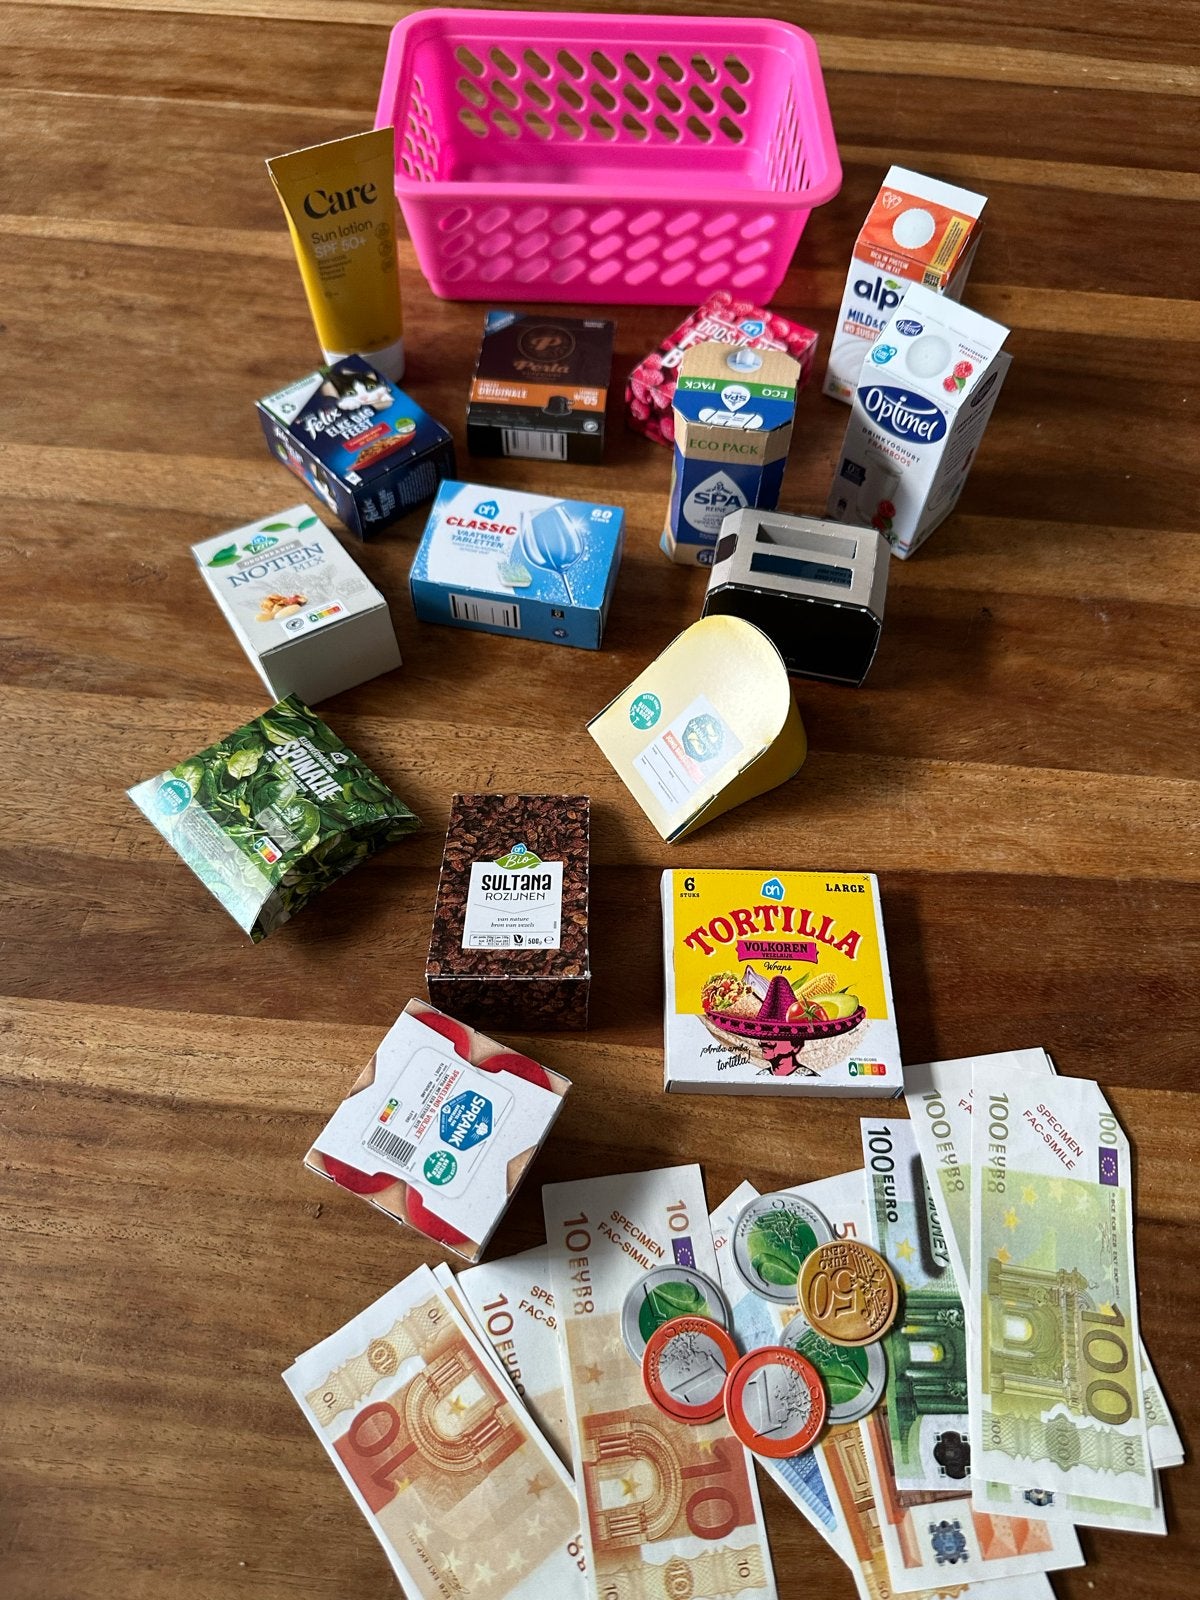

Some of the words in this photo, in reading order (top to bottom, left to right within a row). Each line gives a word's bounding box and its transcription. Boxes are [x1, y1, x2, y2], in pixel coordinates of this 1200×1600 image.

[303, 182, 378, 219] Care
[311, 230, 337, 244] Sun
[338, 220, 373, 238] lotion
[314, 241, 338, 258] SPF
[853, 276, 905, 311] alp
[512, 358, 571, 374] Perla
[684, 380, 716, 391] PACK
[723, 392, 748, 402] SPA
[761, 388, 789, 399] ECO
[304, 407, 343, 441] felix
[324, 416, 352, 438] ELKE
[350, 407, 376, 426] DAG
[865, 387, 939, 441] Optimel
[341, 419, 374, 441] FEEST
[689, 439, 719, 451] ECO
[722, 441, 758, 455] PACK
[861, 427, 921, 463] DRINKYOGHURT
[867, 439, 912, 467] FRAMBOOS
[693, 491, 742, 508] SPA
[705, 505, 727, 513] REINE
[446, 516, 518, 536] CLASSIC
[591, 508, 613, 519] 60
[452, 534, 504, 549] TABLETTEN
[457, 529, 502, 542] VAATWAS
[227, 541, 325, 588] NOTEN
[293, 556, 326, 573] MIX
[274, 740, 345, 802] SPINAZIE
[503, 854, 535, 868] Bio
[481, 874, 552, 891] SULTANA
[684, 877, 696, 892] 6
[825, 883, 866, 894] LARGE
[485, 892, 546, 901] ROZIJNEN
[683, 904, 863, 961] TORTILLA
[743, 941, 809, 954] VOLKOREN
[763, 960, 793, 974] Wraps
[448, 1095, 487, 1147] SPRANK
[988, 1092, 1010, 1141] 100
[1098, 1111, 1118, 1145] 100
[922, 1088, 952, 1139] 100
[944, 1141, 965, 1192] EURO
[1022, 1109, 1076, 1171] FAC-SIMILE
[1036, 1103, 1084, 1157] SPECIMEN
[867, 1125, 895, 1173] 100
[883, 1174, 899, 1223] EURO
[995, 1144, 1007, 1194] EURO
[666, 1199, 690, 1232] 10
[563, 1211, 592, 1253] 10
[610, 1210, 666, 1259] SPECIMEN
[819, 1244, 848, 1258] CENT
[819, 1255, 849, 1270] EURO
[530, 1285, 556, 1309] SPE
[577, 1256, 596, 1314] EURO
[808, 1267, 857, 1320] 50
[427, 1307, 444, 1325] 10
[483, 1293, 514, 1336] 10
[502, 1339, 526, 1396] EURO
[372, 1346, 390, 1371] 10
[1082, 1303, 1132, 1425] 100
[322, 1391, 338, 1409] 10
[990, 1419, 1002, 1445] 100
[348, 1401, 419, 1492] 10
[1122, 1441, 1136, 1467] 100
[680, 1436, 740, 1540] 10
[669, 1566, 689, 1592] 10
[737, 1558, 751, 1578] 10
[604, 1583, 619, 1600] 10
